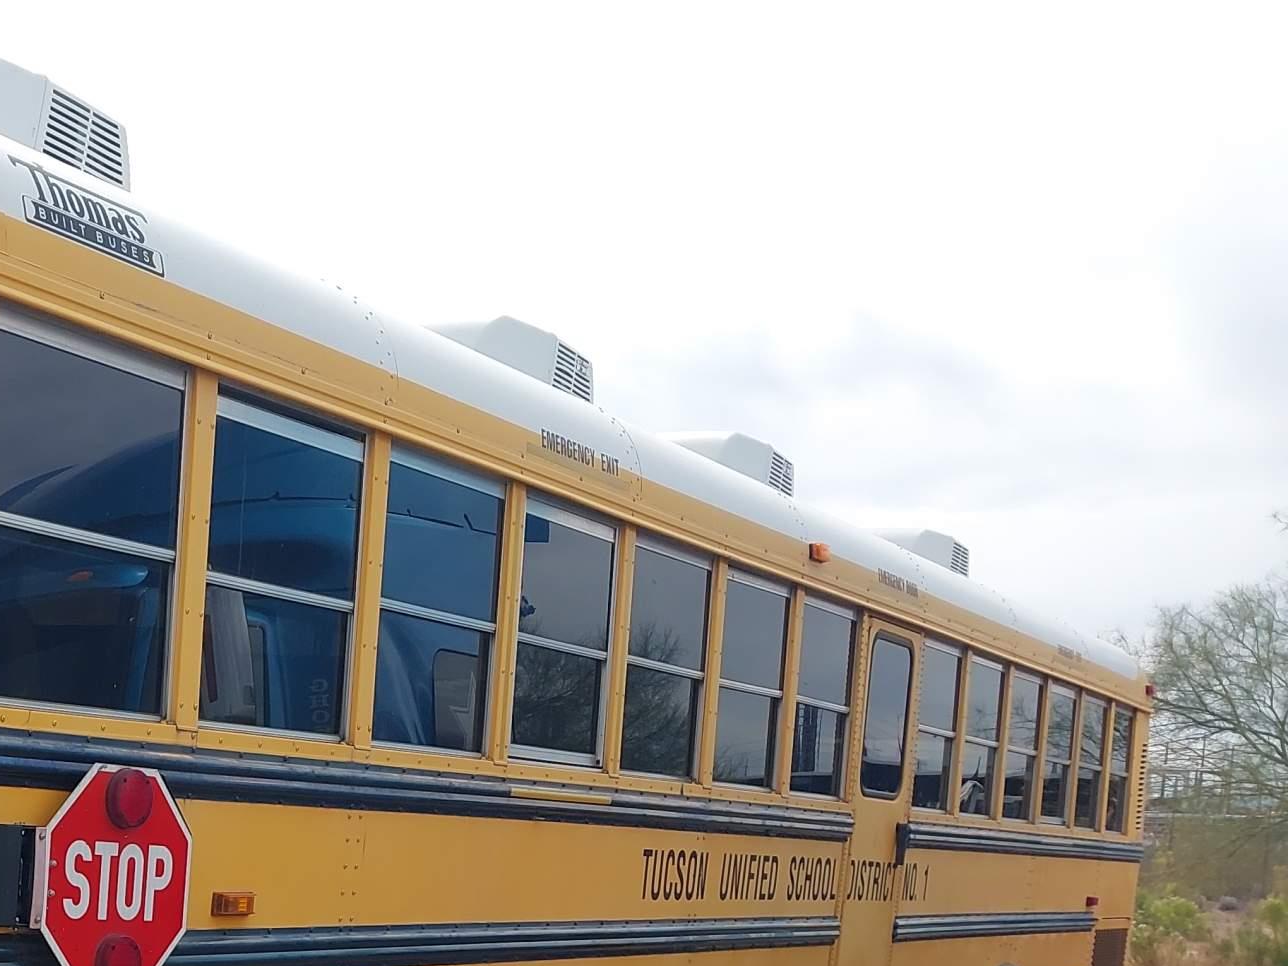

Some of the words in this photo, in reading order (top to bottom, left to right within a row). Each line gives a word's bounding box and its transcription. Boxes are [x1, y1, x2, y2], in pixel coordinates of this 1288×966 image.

[7, 154, 148, 244] Thomas
[38, 206, 87, 236] BUILT
[95, 231, 151, 263] BUSES
[540, 428, 596, 468] EMERGENCY
[600, 453, 620, 477] EXIT
[62, 839, 173, 922] STOP
[642, 848, 710, 901] TUCSON
[719, 852, 779, 901] UNIFIED
[787, 856, 837, 901] SCHOOL
[902, 862, 918, 901] NO.
[922, 863, 930, 901] 1
